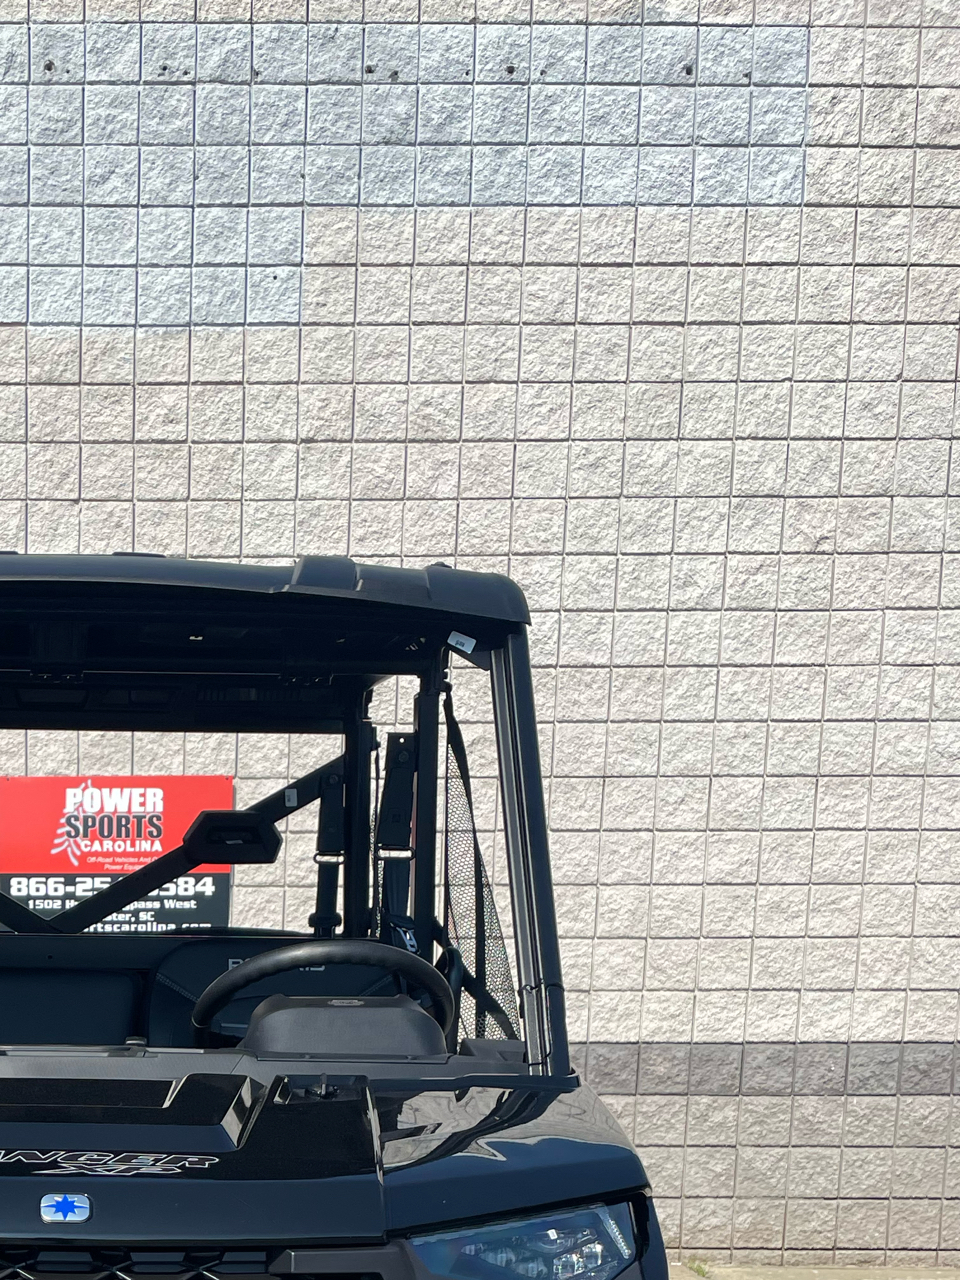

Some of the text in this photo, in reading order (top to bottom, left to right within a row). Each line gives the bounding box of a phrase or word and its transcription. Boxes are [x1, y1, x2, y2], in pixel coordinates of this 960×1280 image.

[64, 787, 164, 813] POWER
[64, 813, 163, 839] SPORTS
[79, 840, 163, 852] CAROLINA
[86, 856, 113, 864] Off-Road
[114, 856, 138, 864] Vehicles
[104, 863, 125, 871] Power
[28, 899, 62, 909] 1502
[164, 899, 197, 909] West
[138, 911, 155, 921] SC
[32, 1163, 183, 1175] XP
